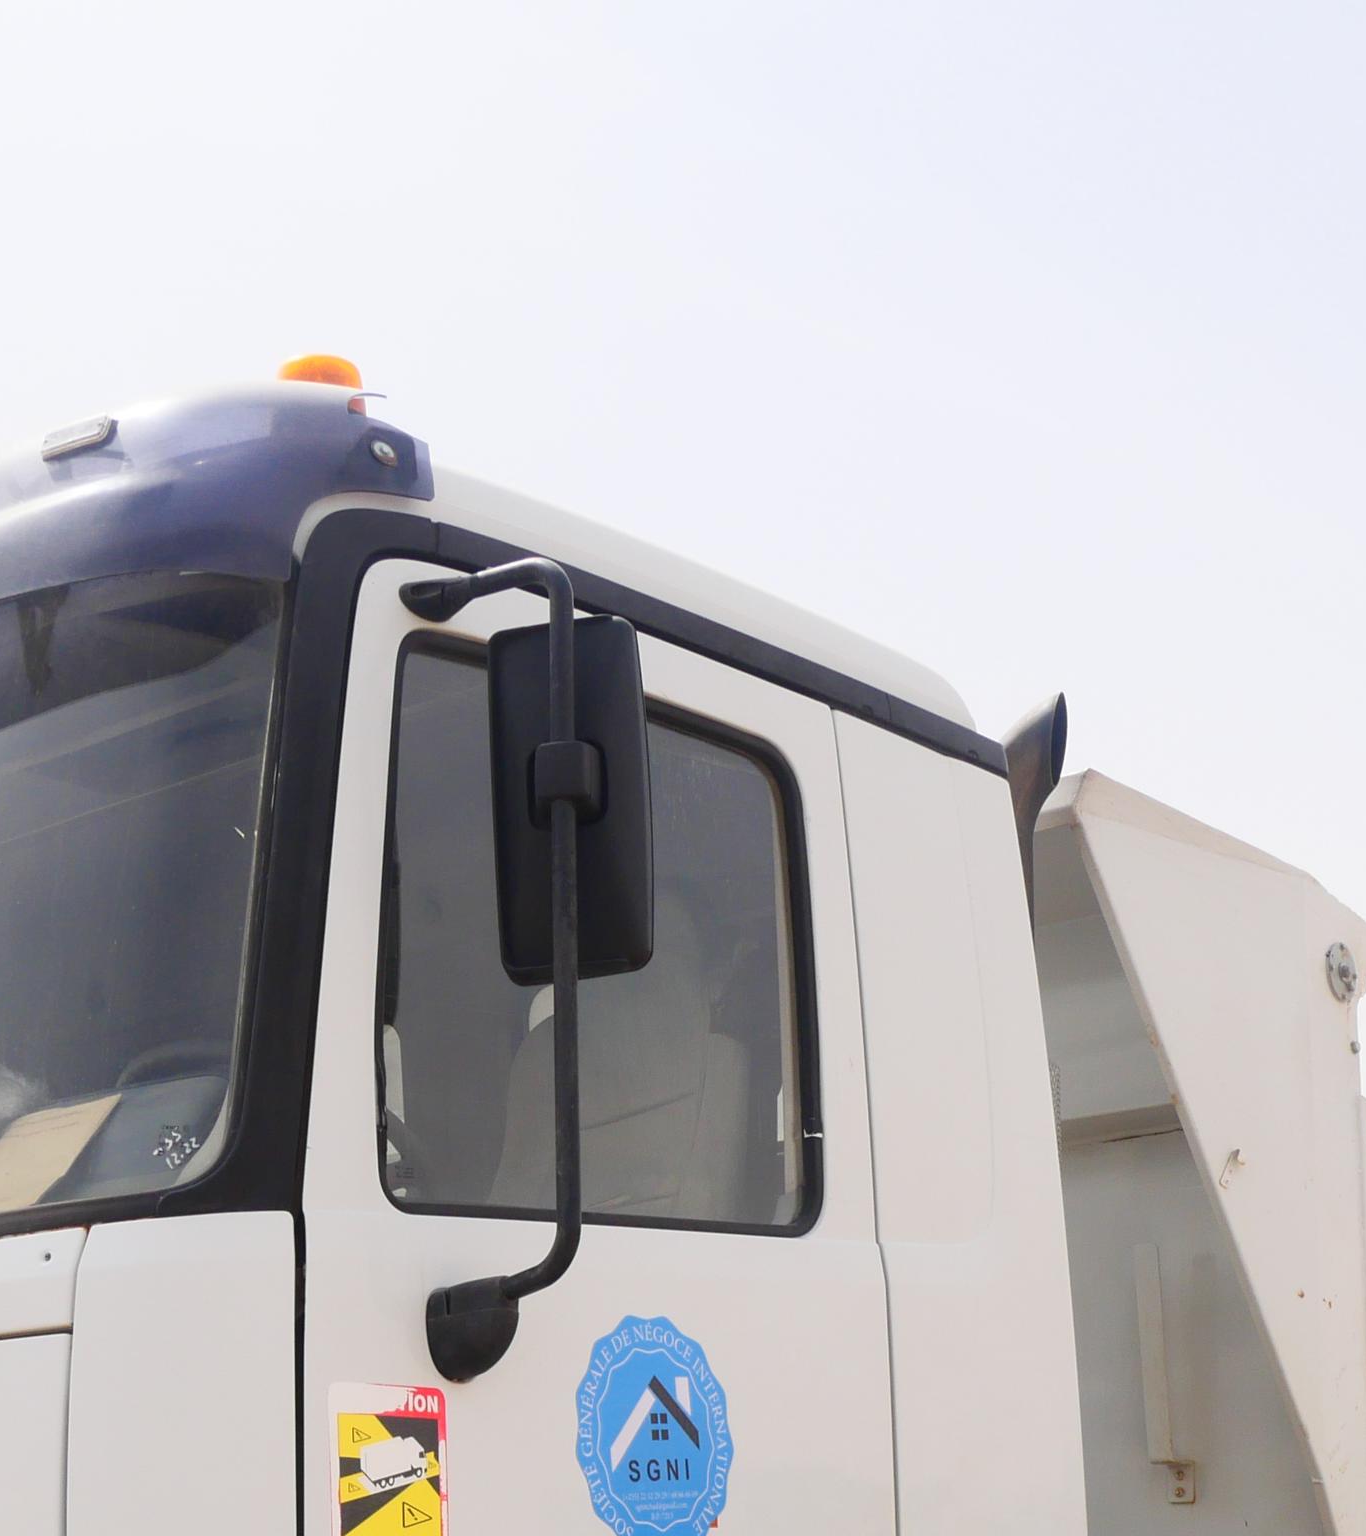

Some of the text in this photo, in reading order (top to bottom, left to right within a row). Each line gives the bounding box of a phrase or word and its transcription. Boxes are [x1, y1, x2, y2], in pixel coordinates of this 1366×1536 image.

[610, 1329, 633, 1354] DE
[632, 1322, 694, 1362] NÉGOCE
[692, 1357, 729, 1536] INTERNATIONALE
[628, 1458, 690, 1483] SGNI
